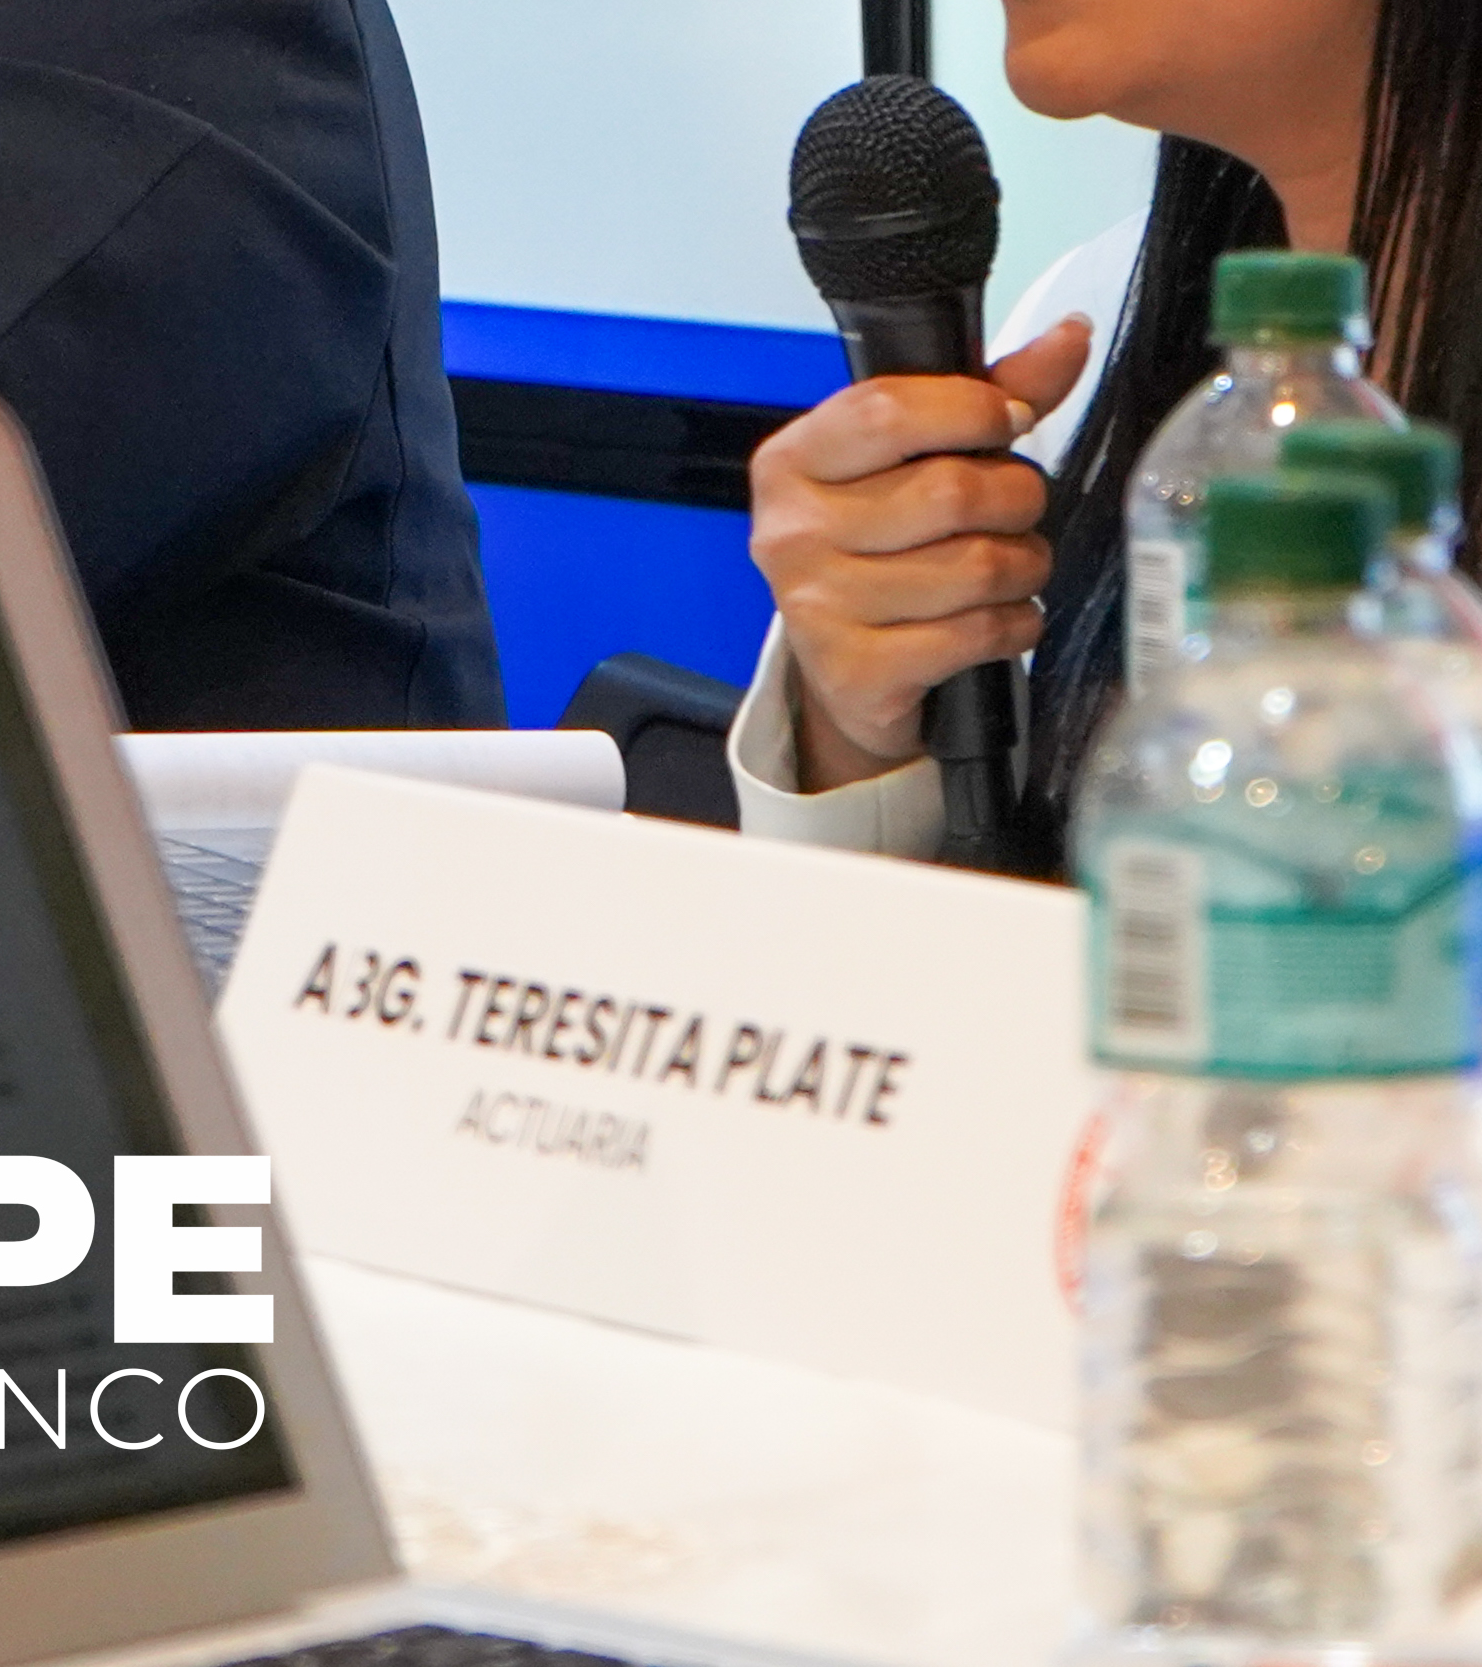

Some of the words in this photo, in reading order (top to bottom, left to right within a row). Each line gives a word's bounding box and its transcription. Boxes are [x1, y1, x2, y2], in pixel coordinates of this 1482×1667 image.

[445, 965, 705, 1091] TERESITA
[713, 1022, 910, 1127] PLATE
[453, 1085, 654, 1173] ACTUARIA
